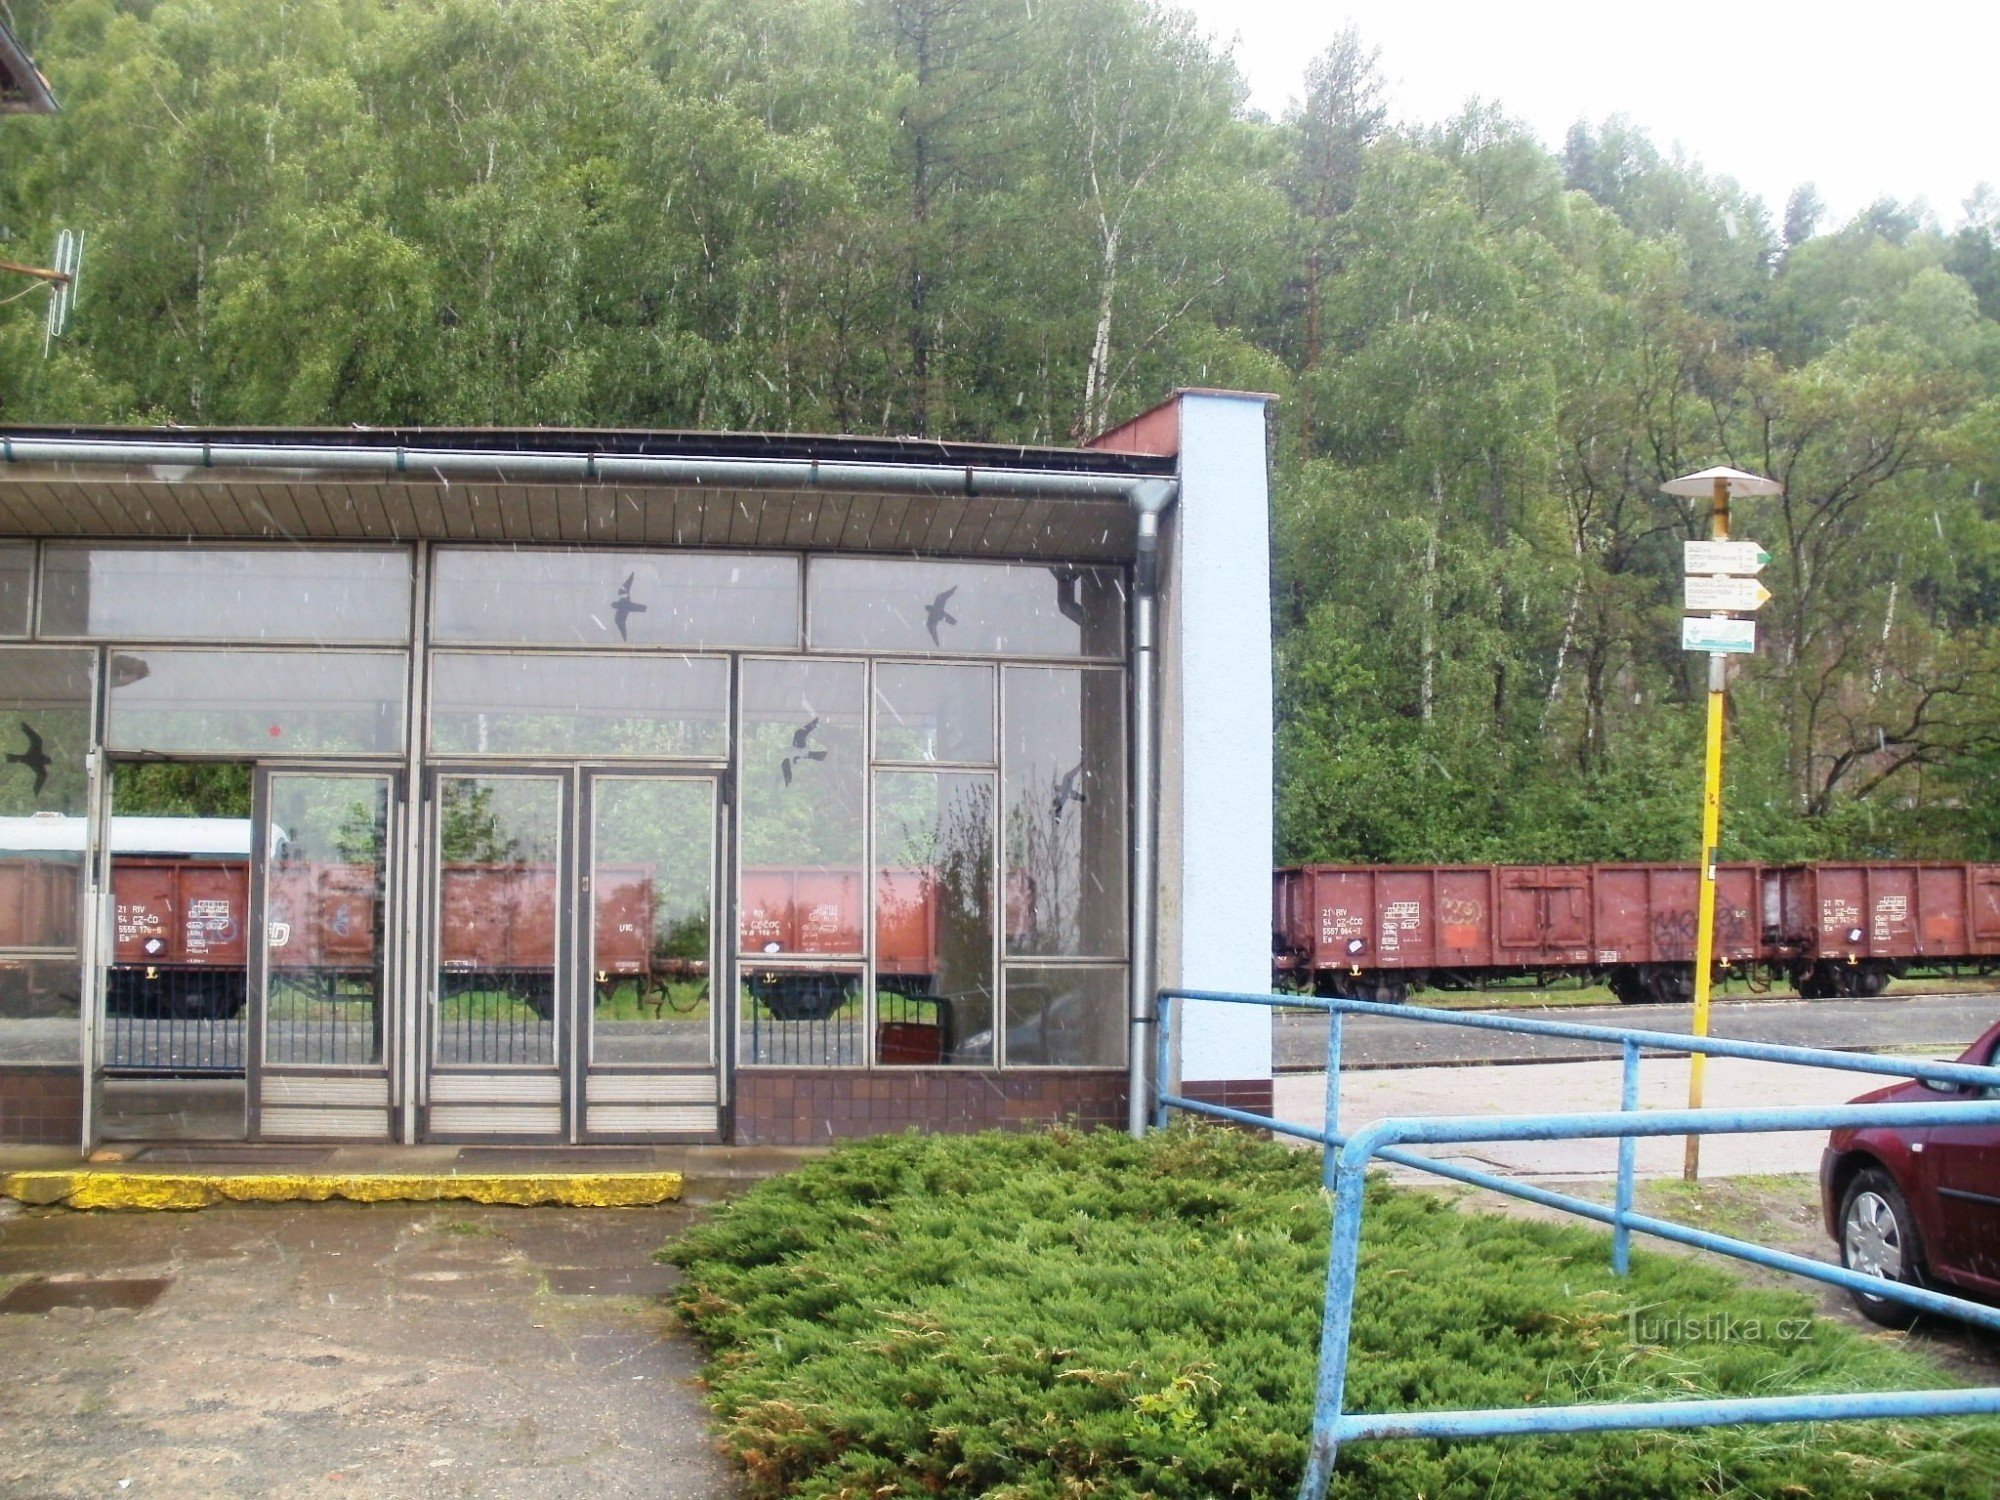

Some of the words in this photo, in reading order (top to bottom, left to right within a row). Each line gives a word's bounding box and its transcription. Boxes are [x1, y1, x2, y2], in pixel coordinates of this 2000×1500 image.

[117, 905, 127, 913] 21
[132, 905, 145, 913] RIV
[1322, 908, 1331, 917] 21
[1335, 908, 1347, 916] RIV
[117, 915, 127, 923] 54
[1322, 918, 1332, 926] 54
[118, 925, 137, 933] 5555
